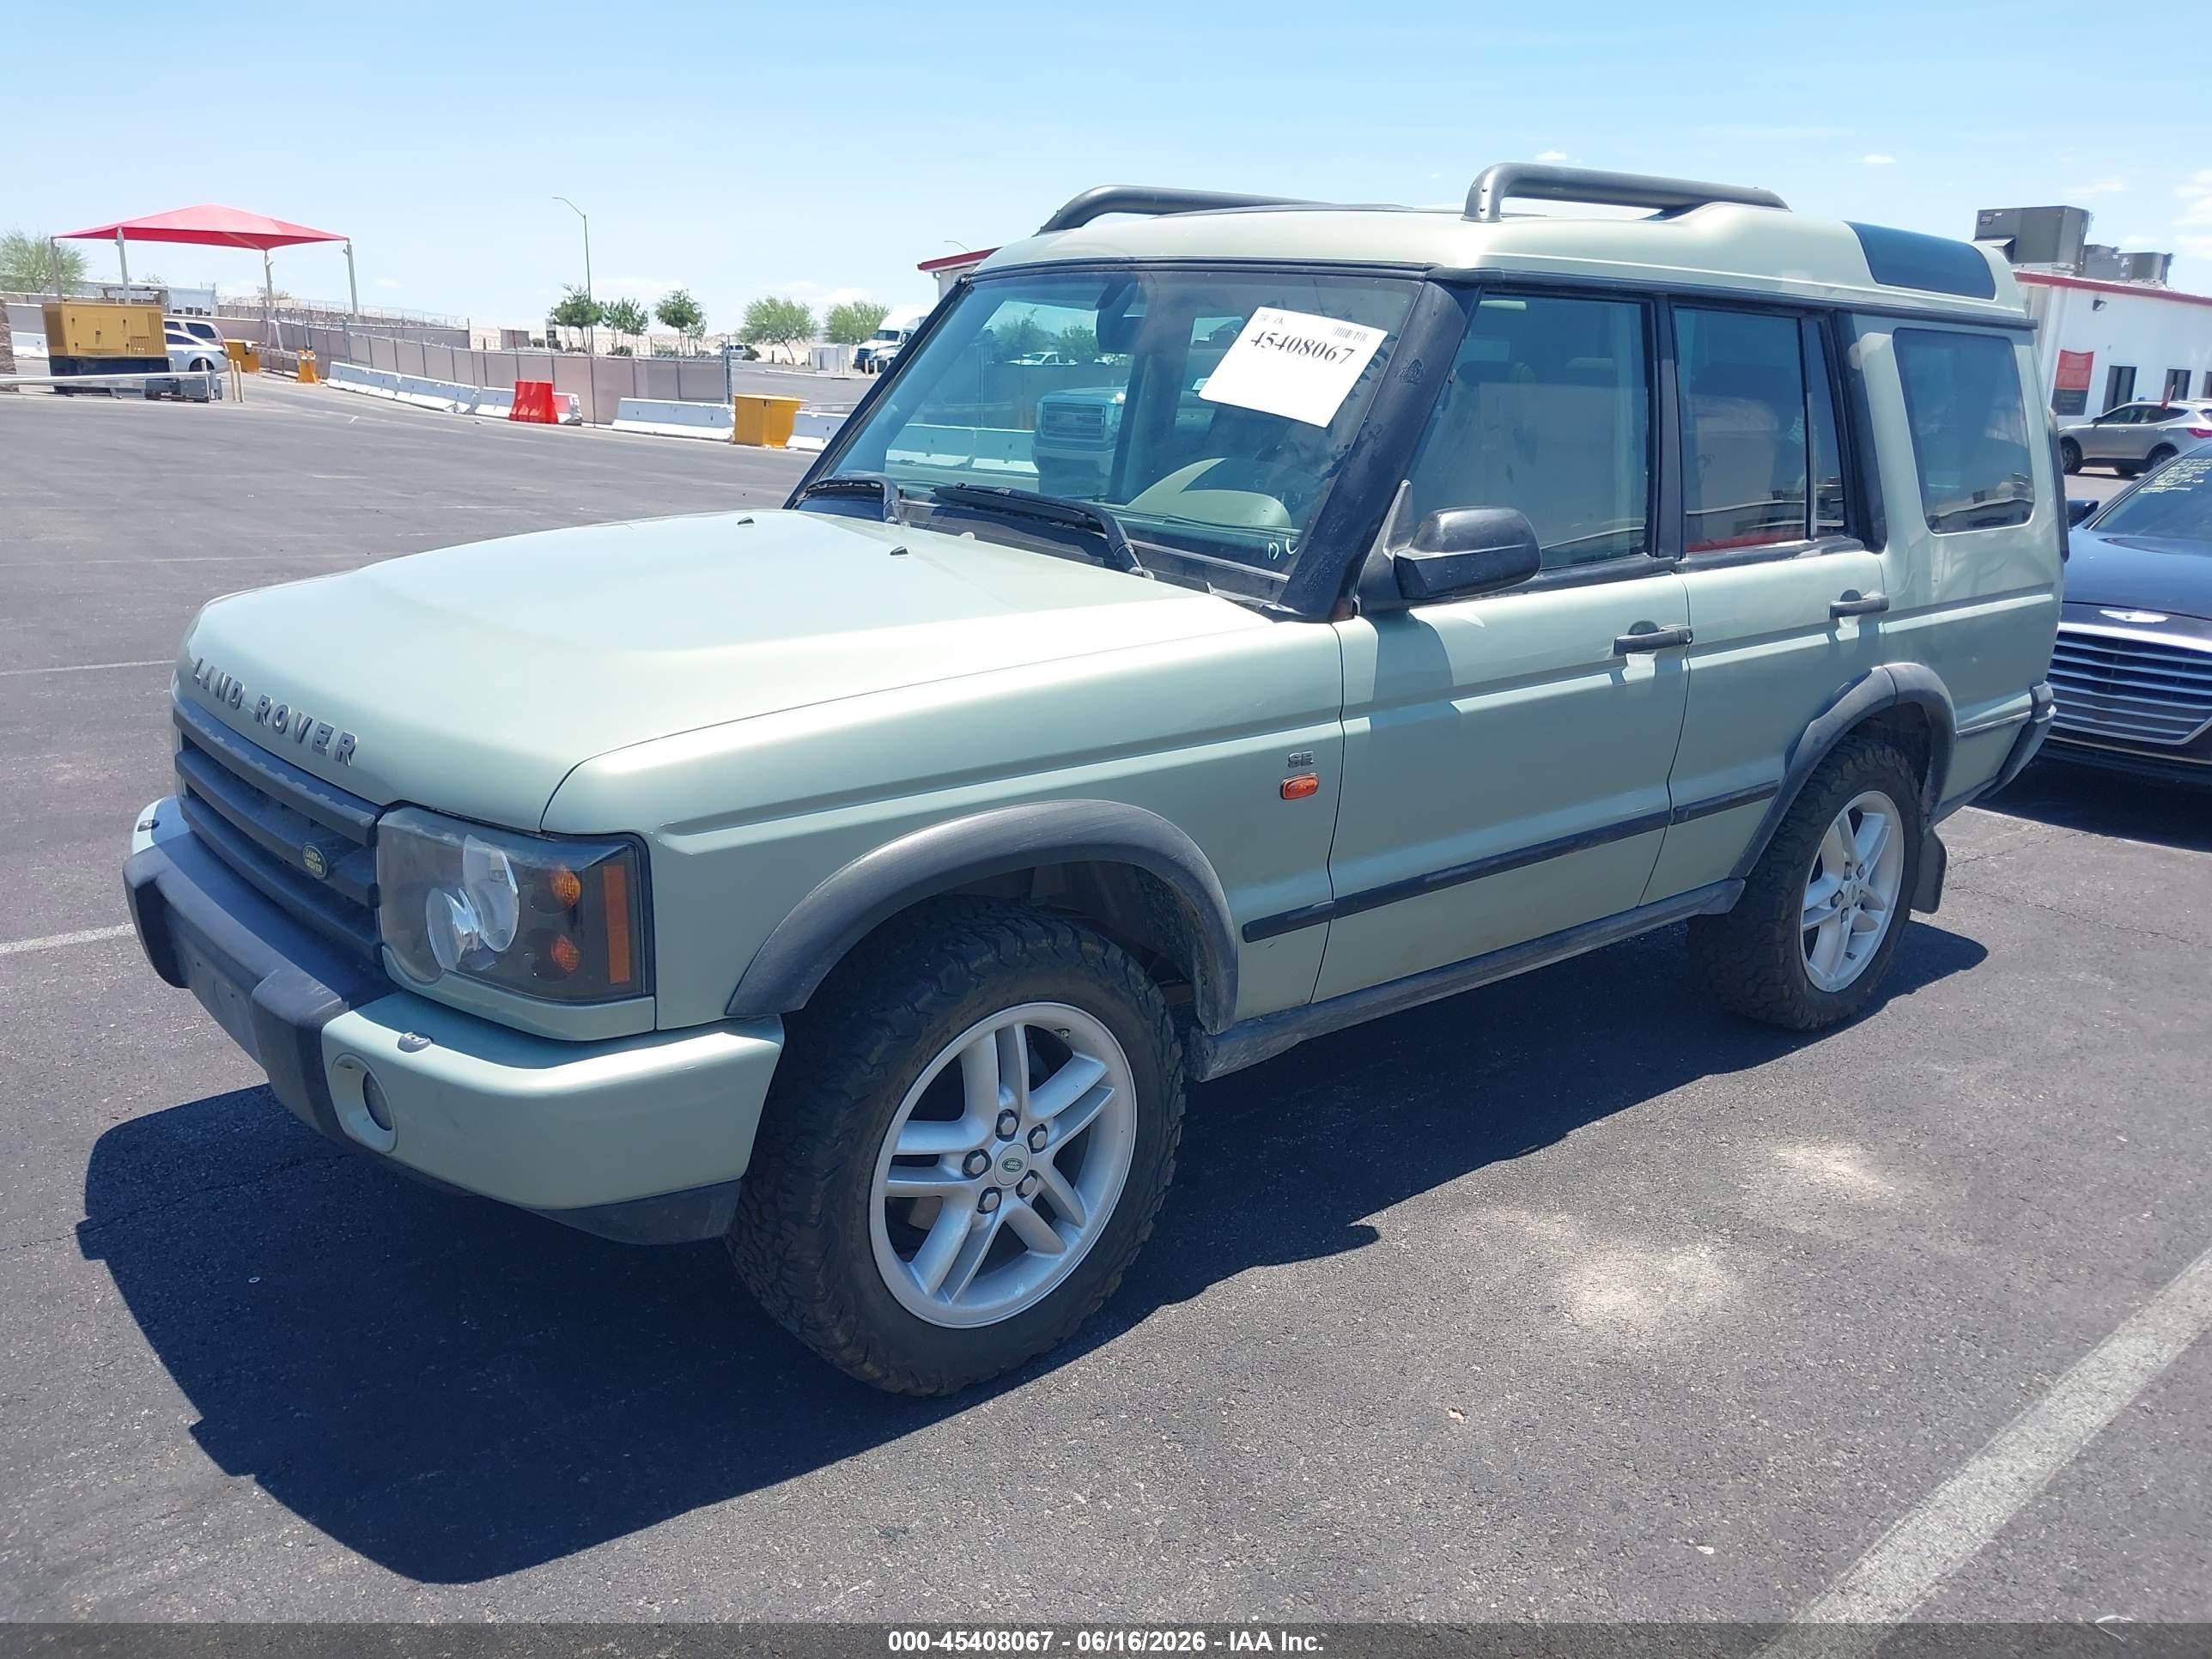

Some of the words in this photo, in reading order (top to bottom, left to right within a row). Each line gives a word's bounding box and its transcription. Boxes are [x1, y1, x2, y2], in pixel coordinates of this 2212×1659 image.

[1250, 330, 1356, 365] 45408067
[192, 658, 246, 709] LAND
[254, 693, 358, 768] ROVER
[1287, 750, 1315, 769] SE
